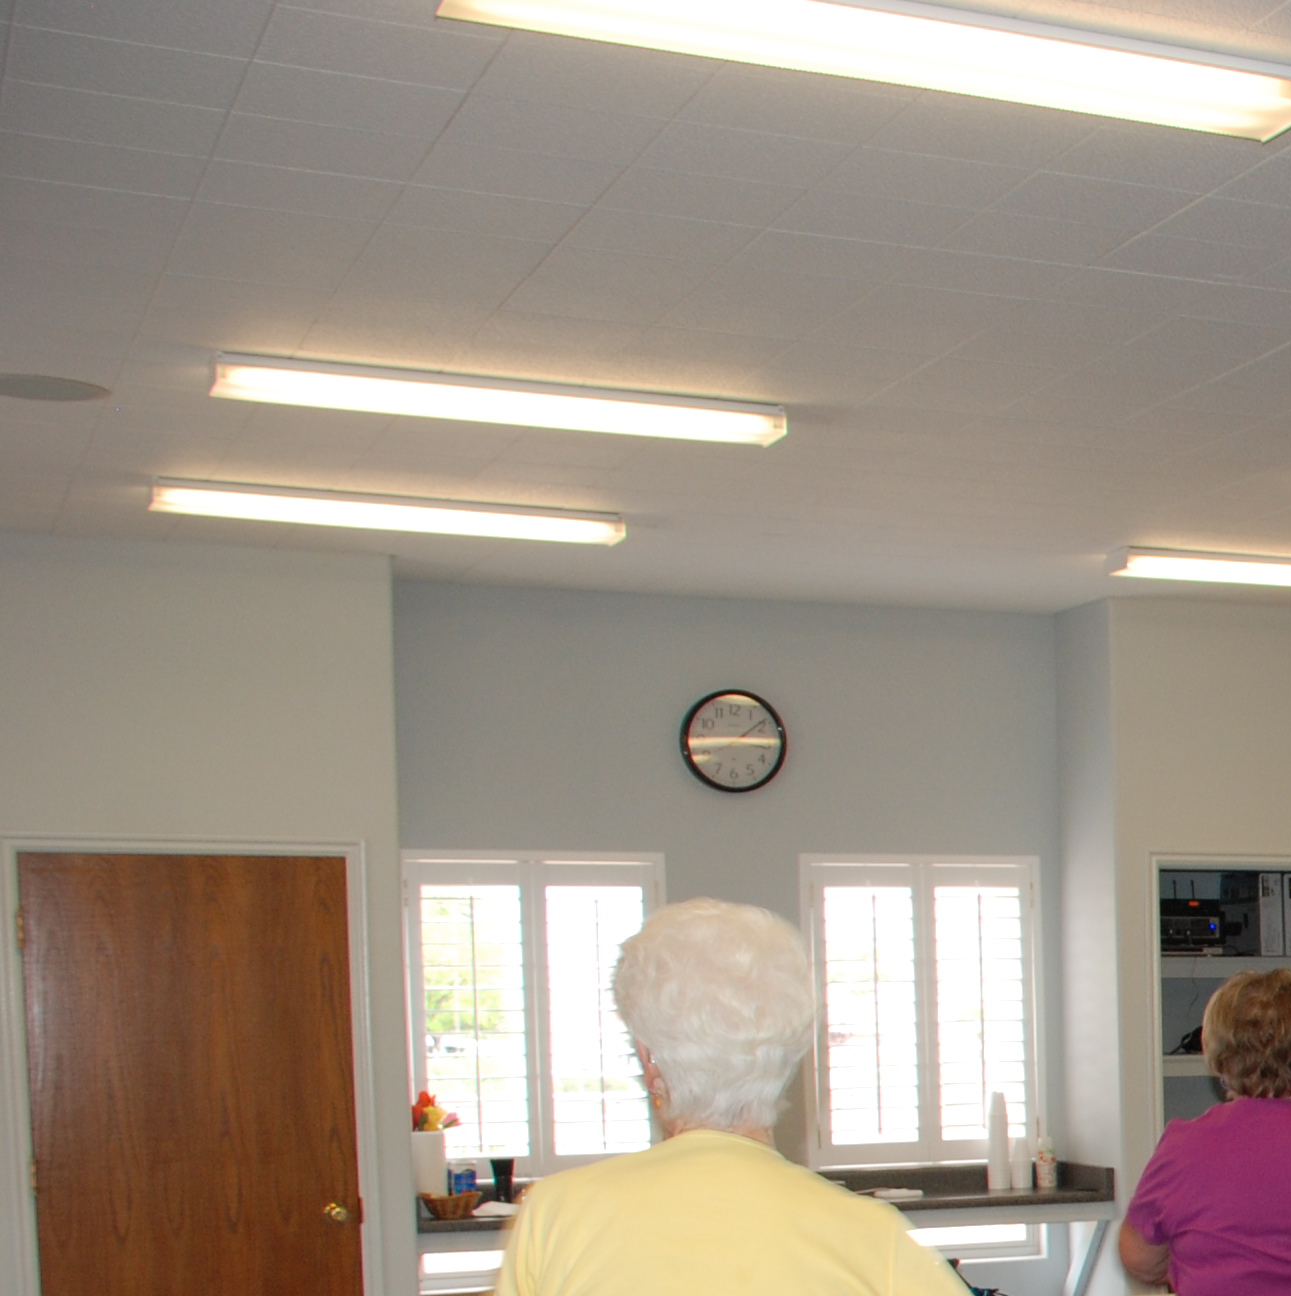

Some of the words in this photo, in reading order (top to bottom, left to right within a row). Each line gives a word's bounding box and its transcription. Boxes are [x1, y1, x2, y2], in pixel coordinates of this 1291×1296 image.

[715, 707, 723, 718] 11
[728, 705, 741, 716] 12
[701, 718, 715, 730] 10
[758, 754, 765, 765] 4
[729, 767, 739, 779] 6
[746, 764, 754, 775] 5
